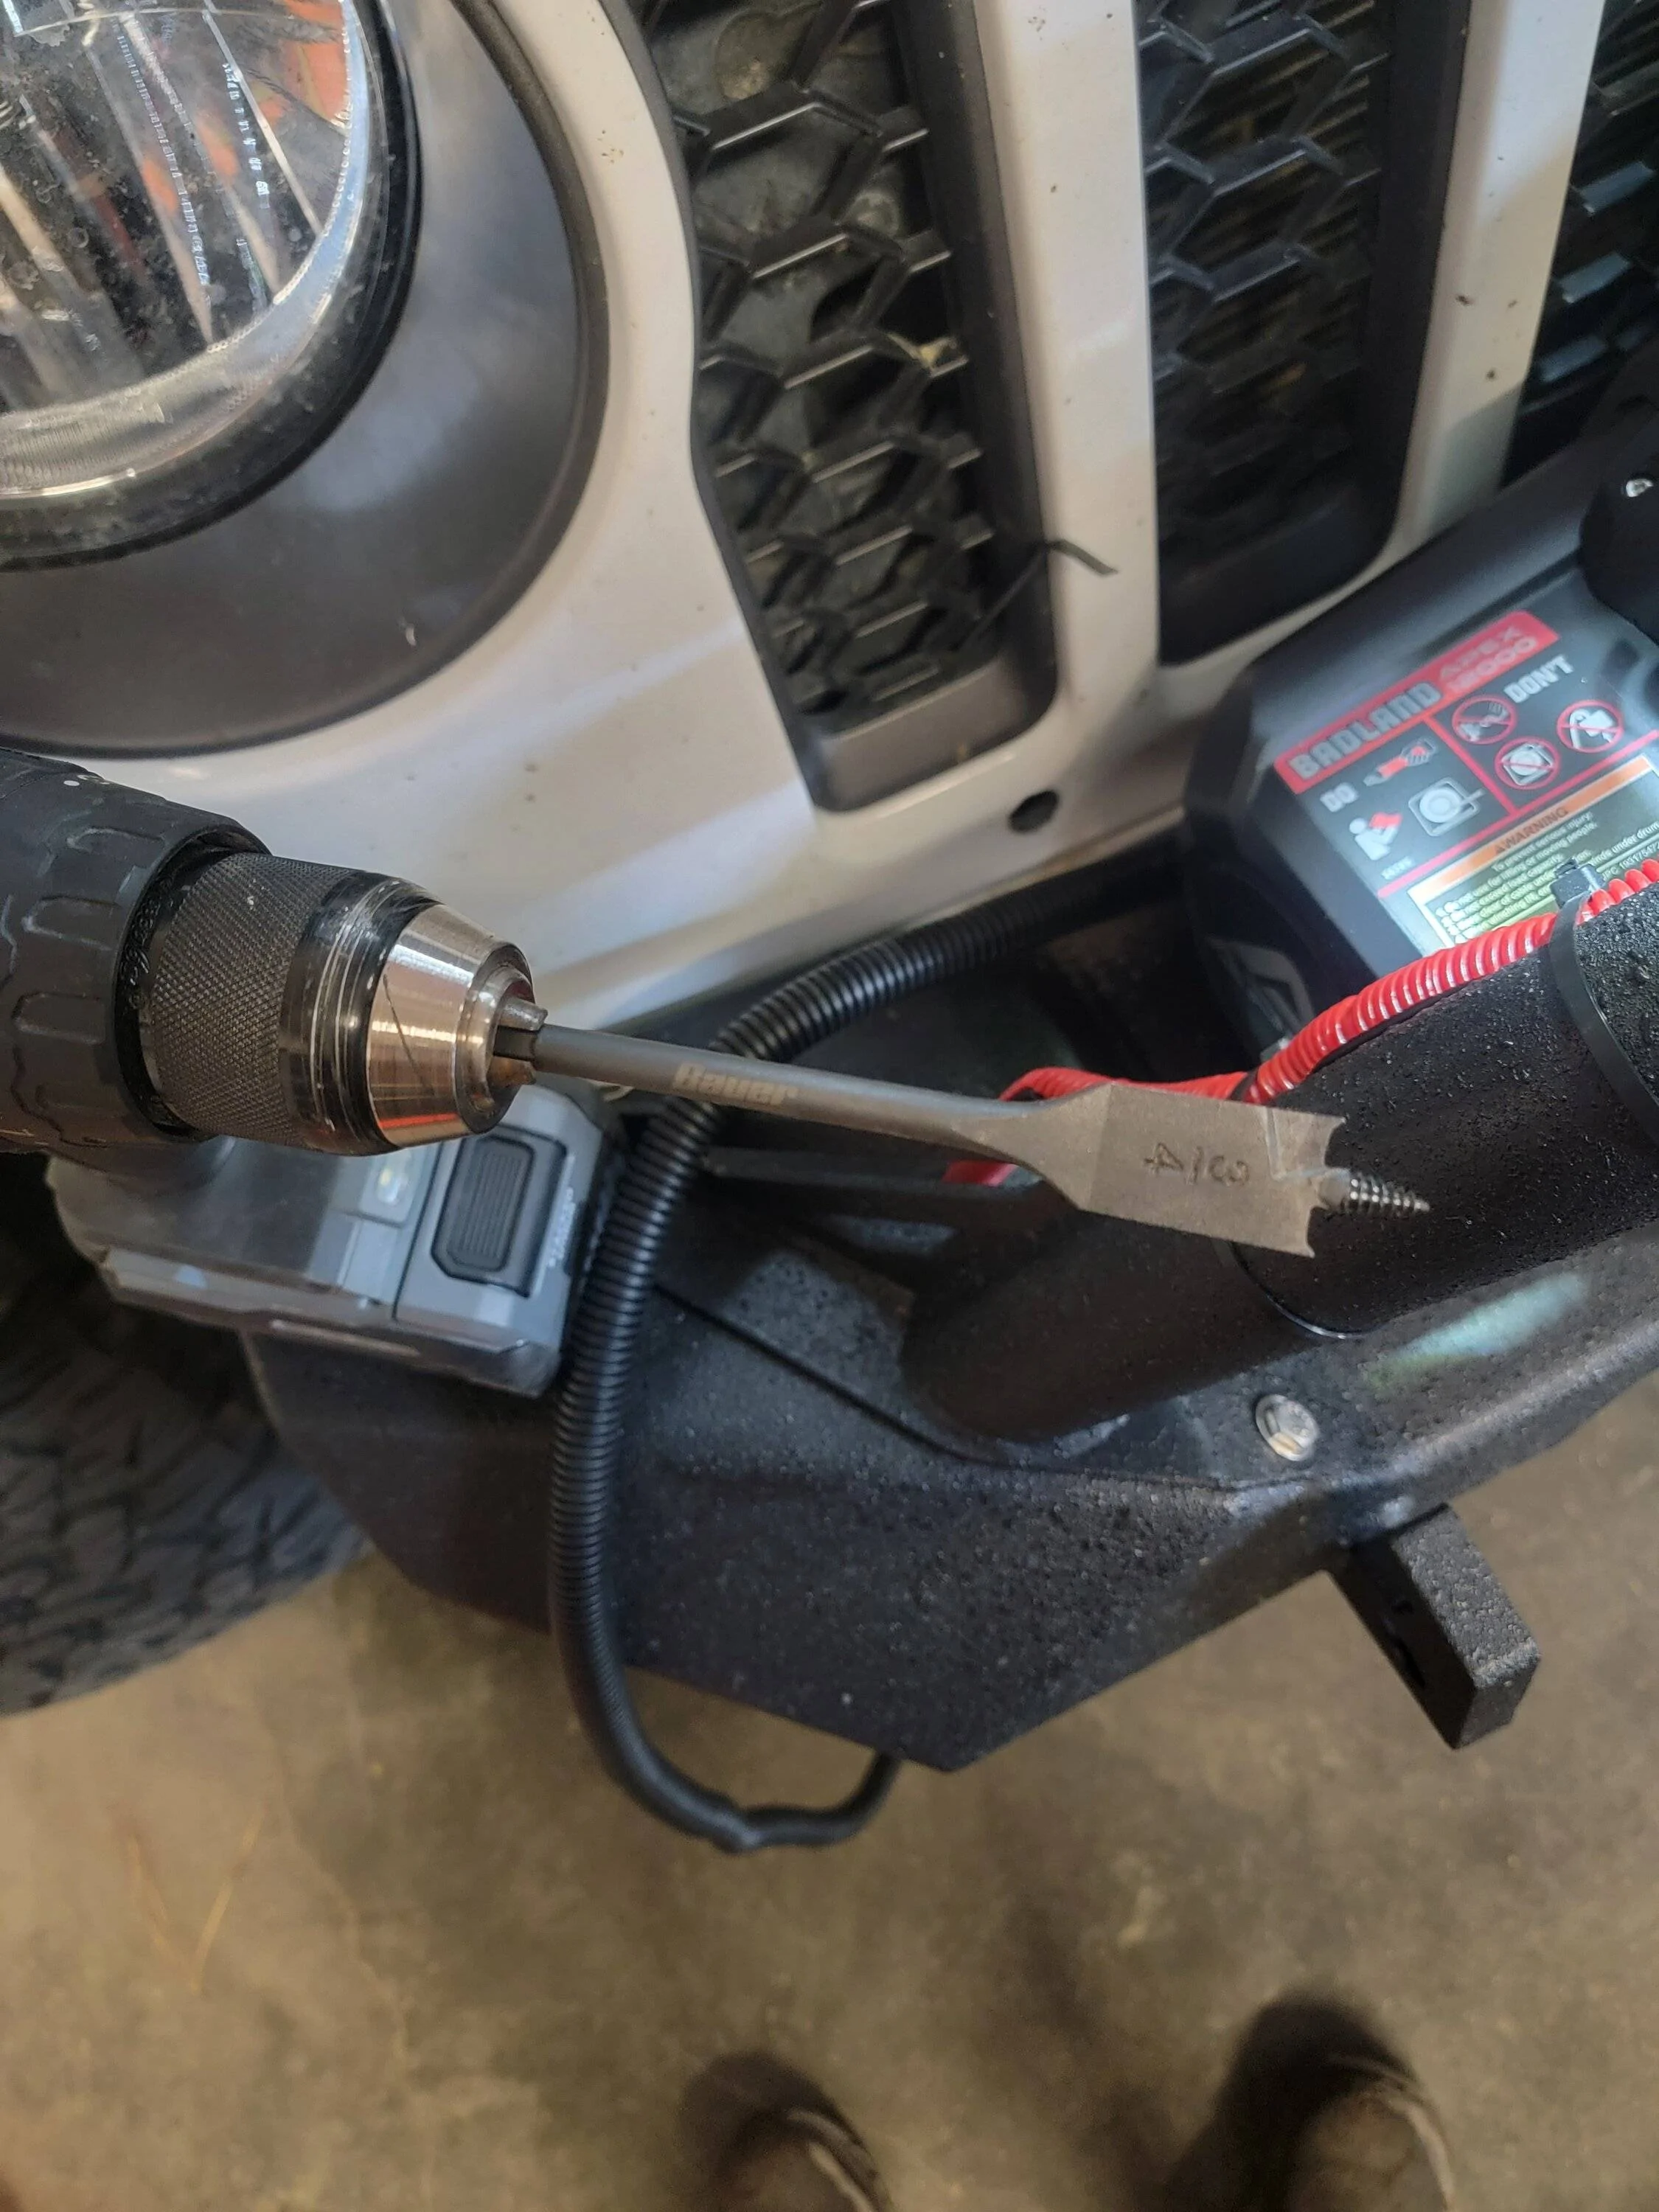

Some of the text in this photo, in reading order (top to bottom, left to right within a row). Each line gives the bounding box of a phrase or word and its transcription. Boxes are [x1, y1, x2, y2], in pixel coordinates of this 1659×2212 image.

[1504, 654, 1573, 703] DON'T
[1288, 682, 1441, 779] BADLAND
[1320, 782, 1358, 812] DO
[1502, 804, 1569, 849] WARNING
[1610, 833, 1639, 855] under
[1503, 843, 1537, 868] prevent
[672, 1061, 800, 1106] Bauer
